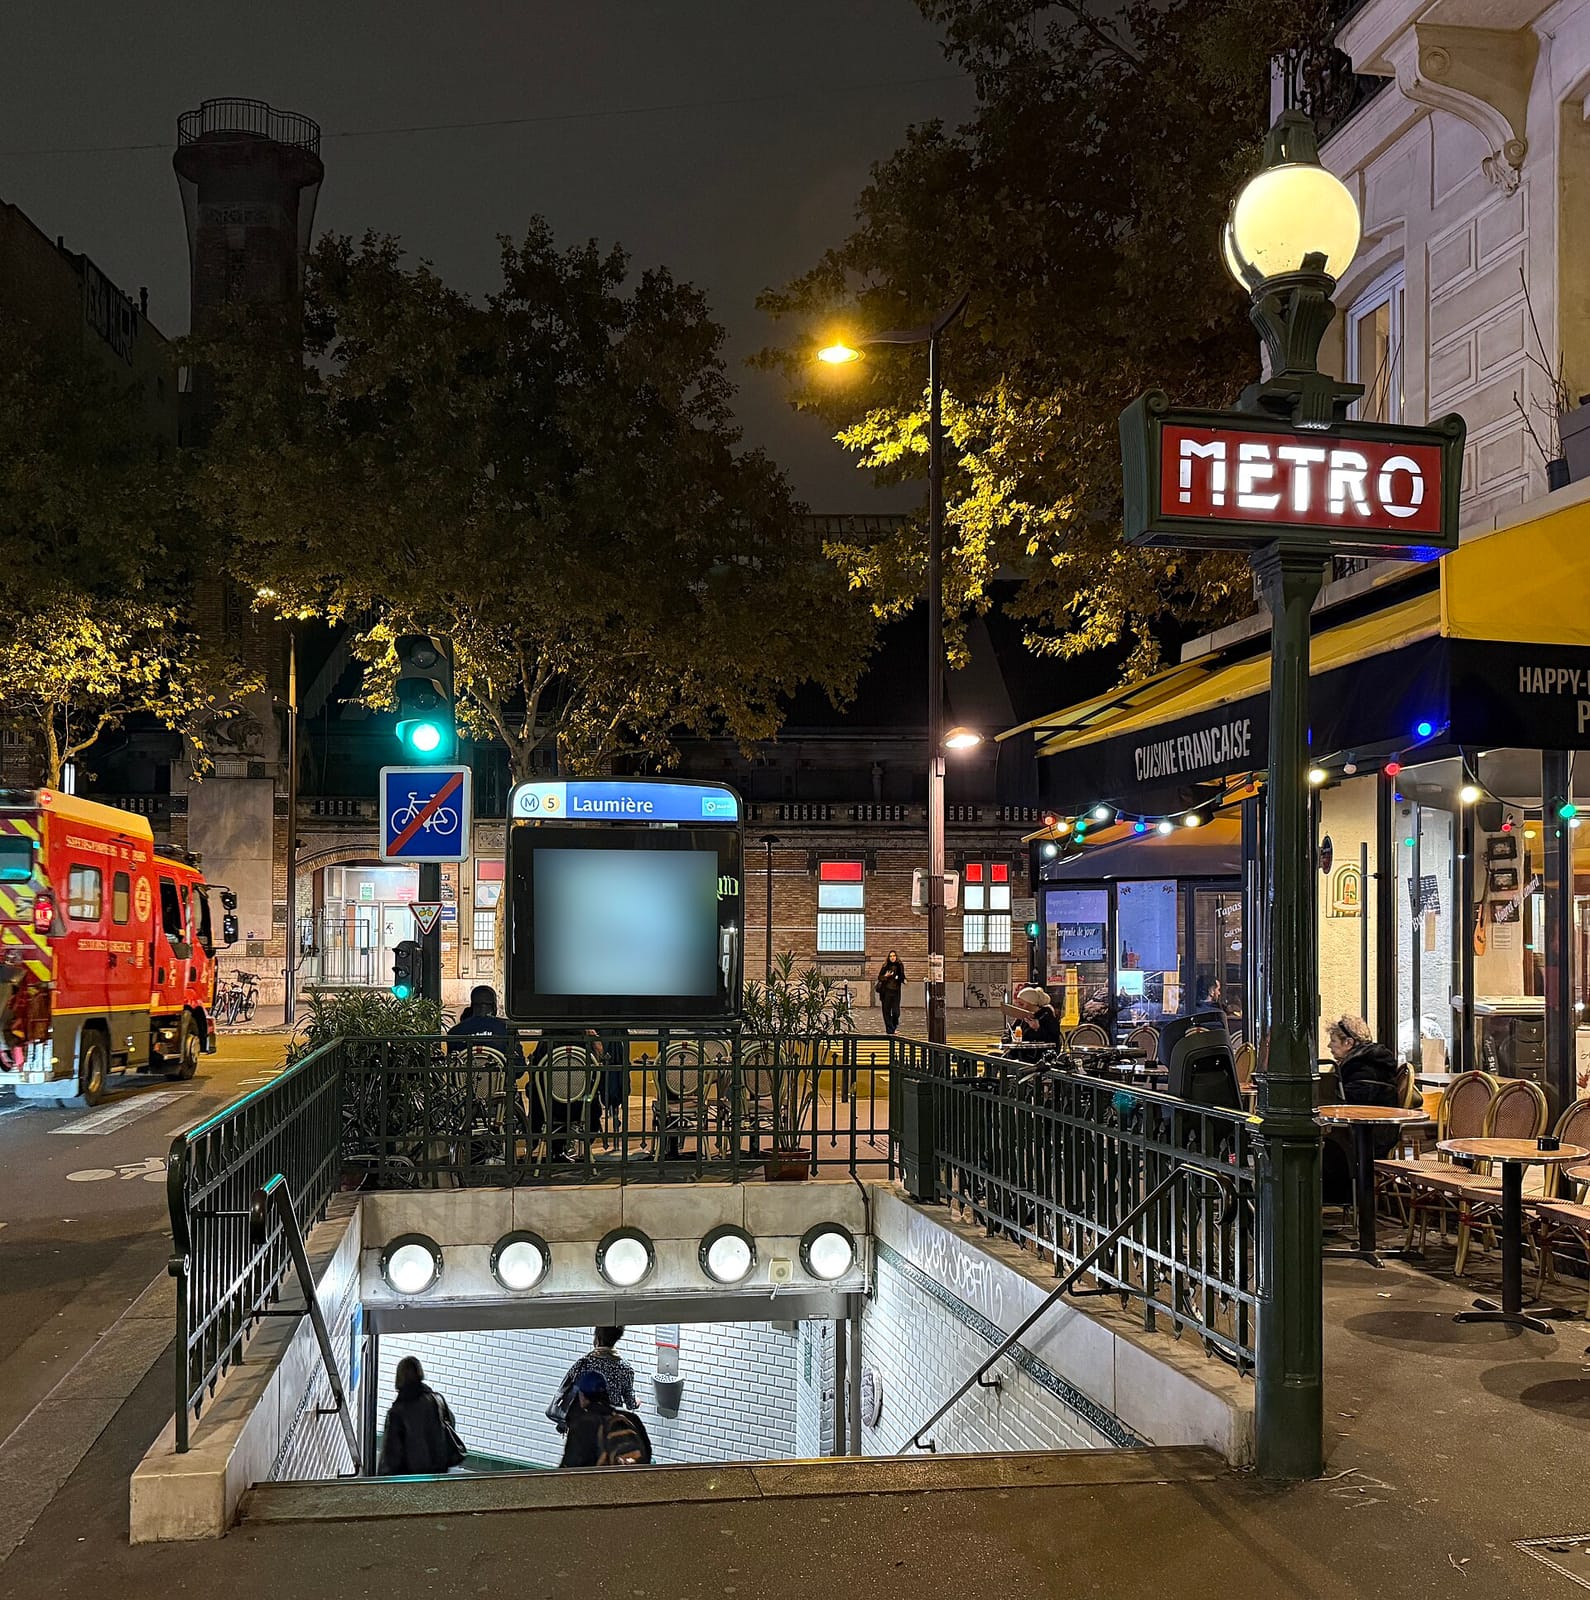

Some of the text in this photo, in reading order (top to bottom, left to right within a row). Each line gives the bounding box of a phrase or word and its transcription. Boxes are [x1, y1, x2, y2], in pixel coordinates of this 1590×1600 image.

[1179, 439, 1424, 518] METRO
[1135, 739, 1178, 781] CUISINE
[547, 799, 555, 809] 5
[573, 796, 654, 813] Laumière
[1215, 902, 1242, 918] Tapas
